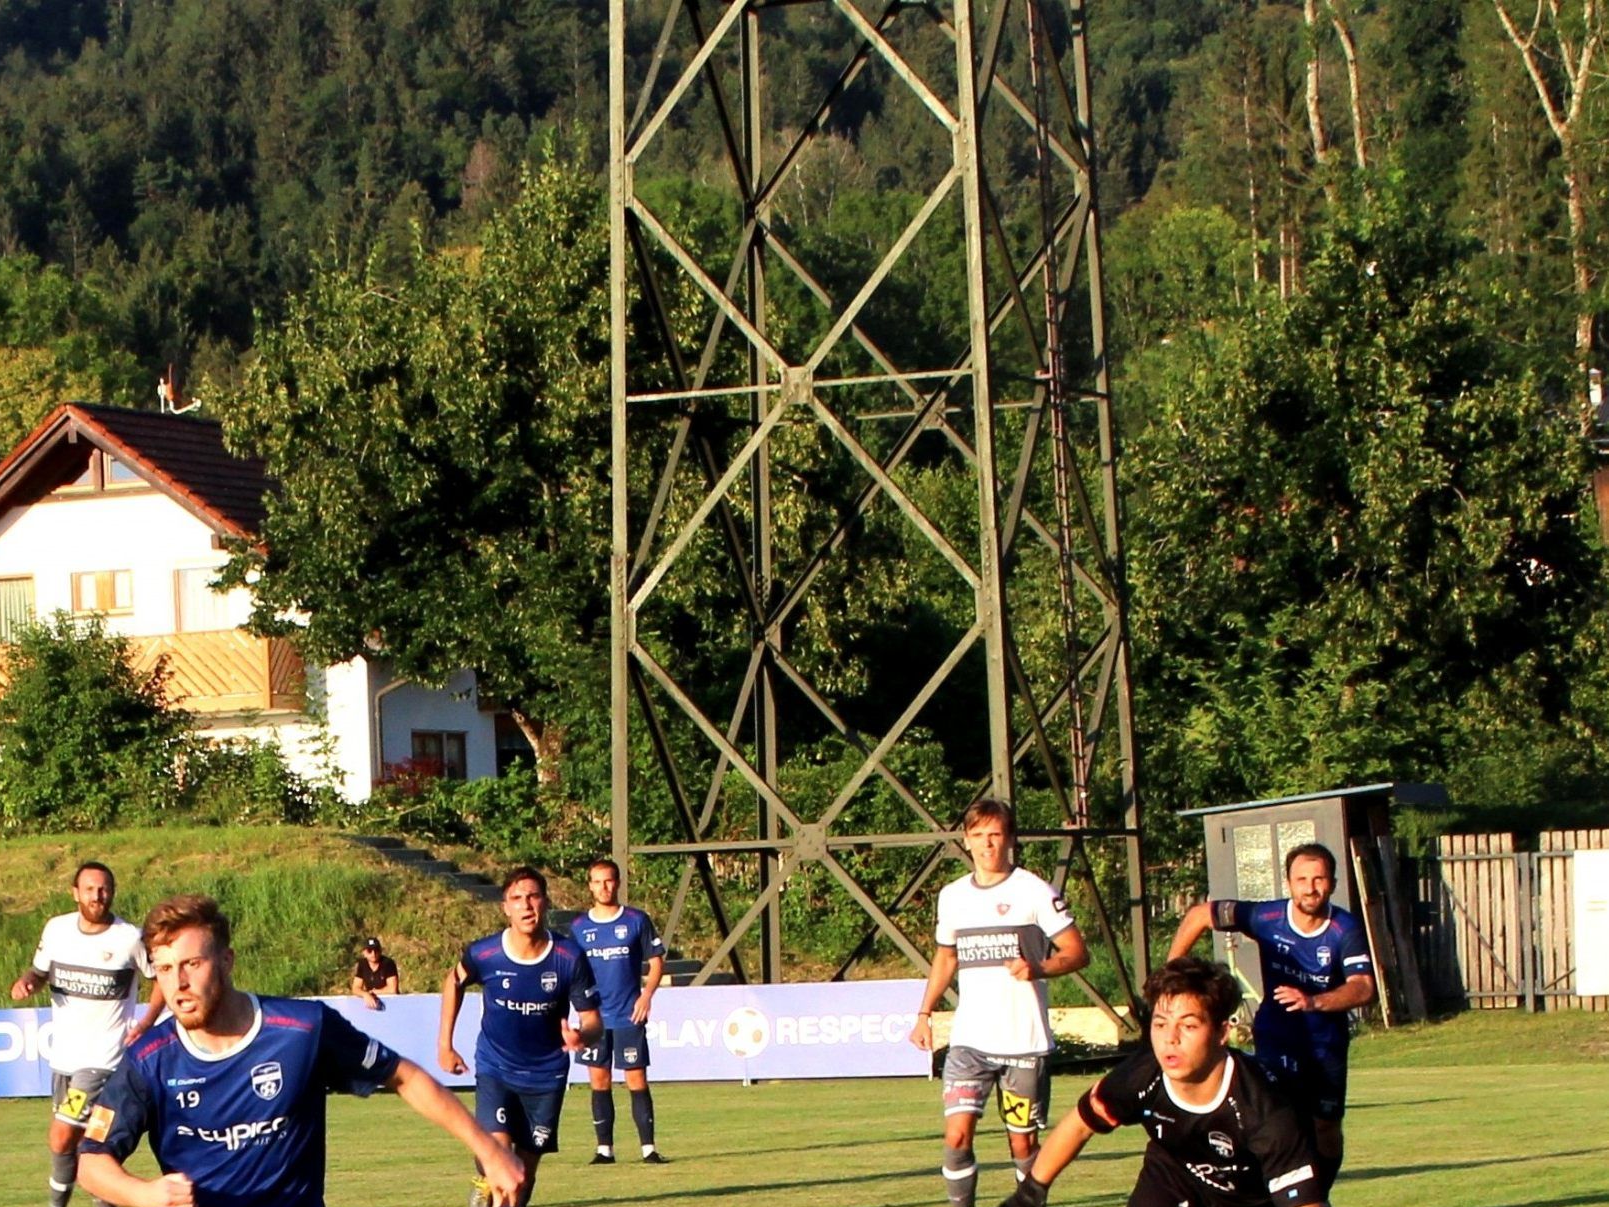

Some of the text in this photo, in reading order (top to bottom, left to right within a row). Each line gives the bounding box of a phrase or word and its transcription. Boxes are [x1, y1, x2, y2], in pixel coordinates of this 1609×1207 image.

[956, 933, 1019, 950] AUFMANN
[957, 945, 1021, 962] AUSYSTEME
[501, 977, 510, 990] 6
[581, 1047, 599, 1061] 21
[175, 1090, 200, 1109] 19
[495, 1106, 507, 1125] 6
[197, 1116, 288, 1151] typico
[1155, 1123, 1163, 1140] 1
